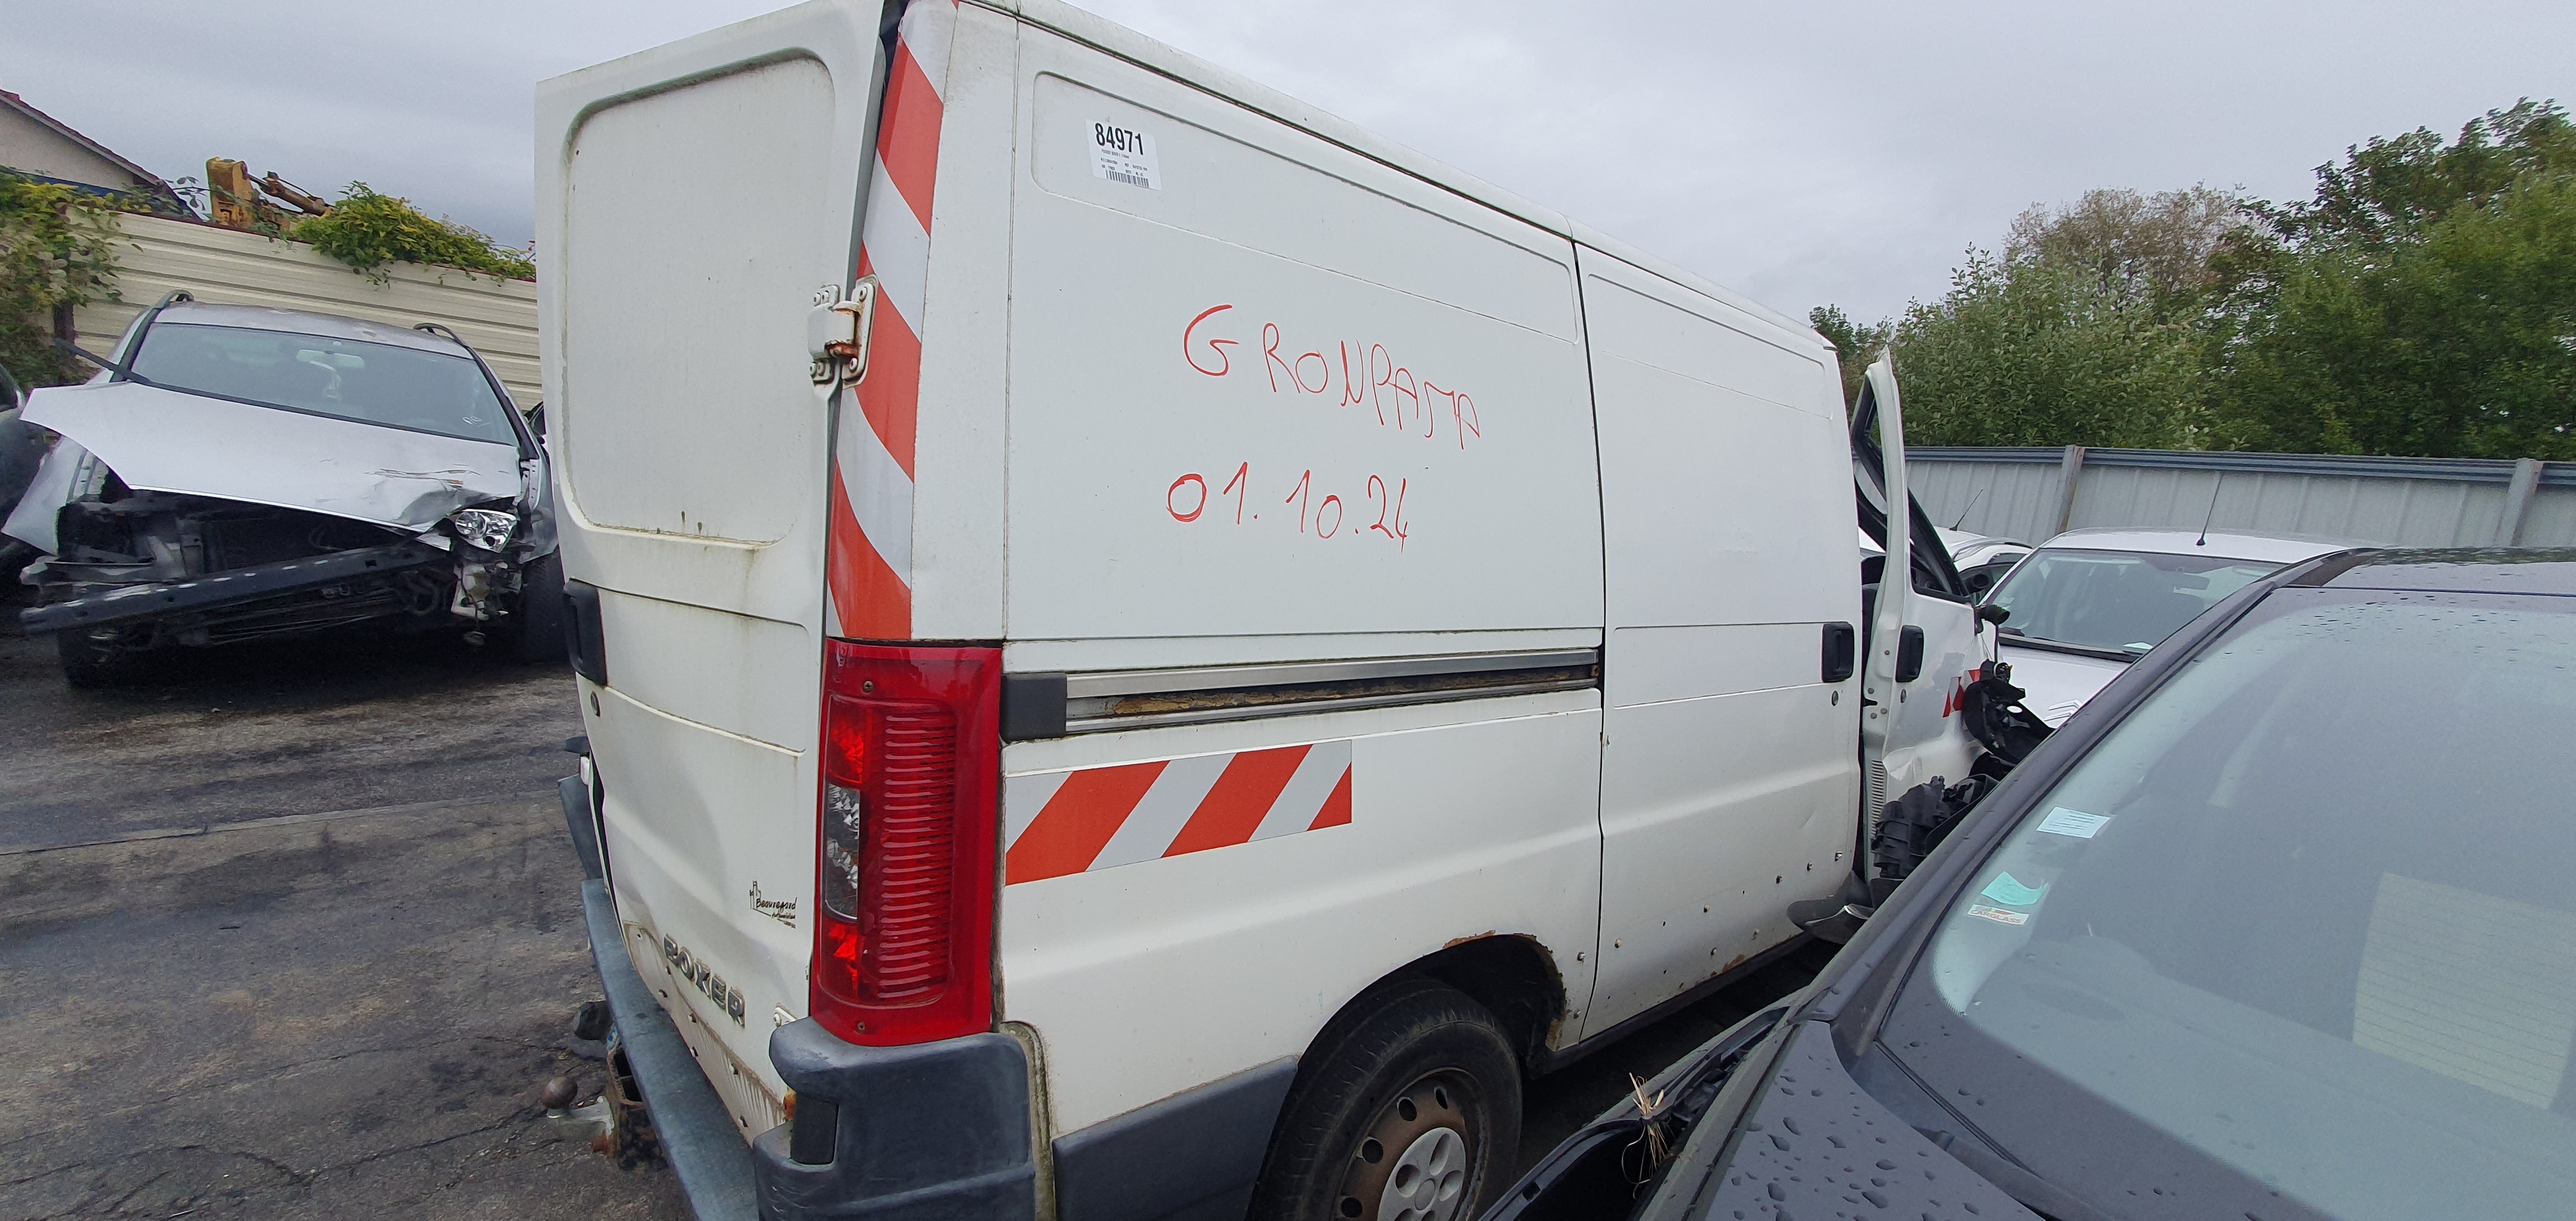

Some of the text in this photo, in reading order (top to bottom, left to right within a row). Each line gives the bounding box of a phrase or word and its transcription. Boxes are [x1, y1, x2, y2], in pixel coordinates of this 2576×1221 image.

[1095, 122, 1144, 155] 84971
[756, 897, 798, 914] Beauregard
[1971, 910, 2021, 924] CARGLASS
[663, 934, 745, 1029] BOXER
